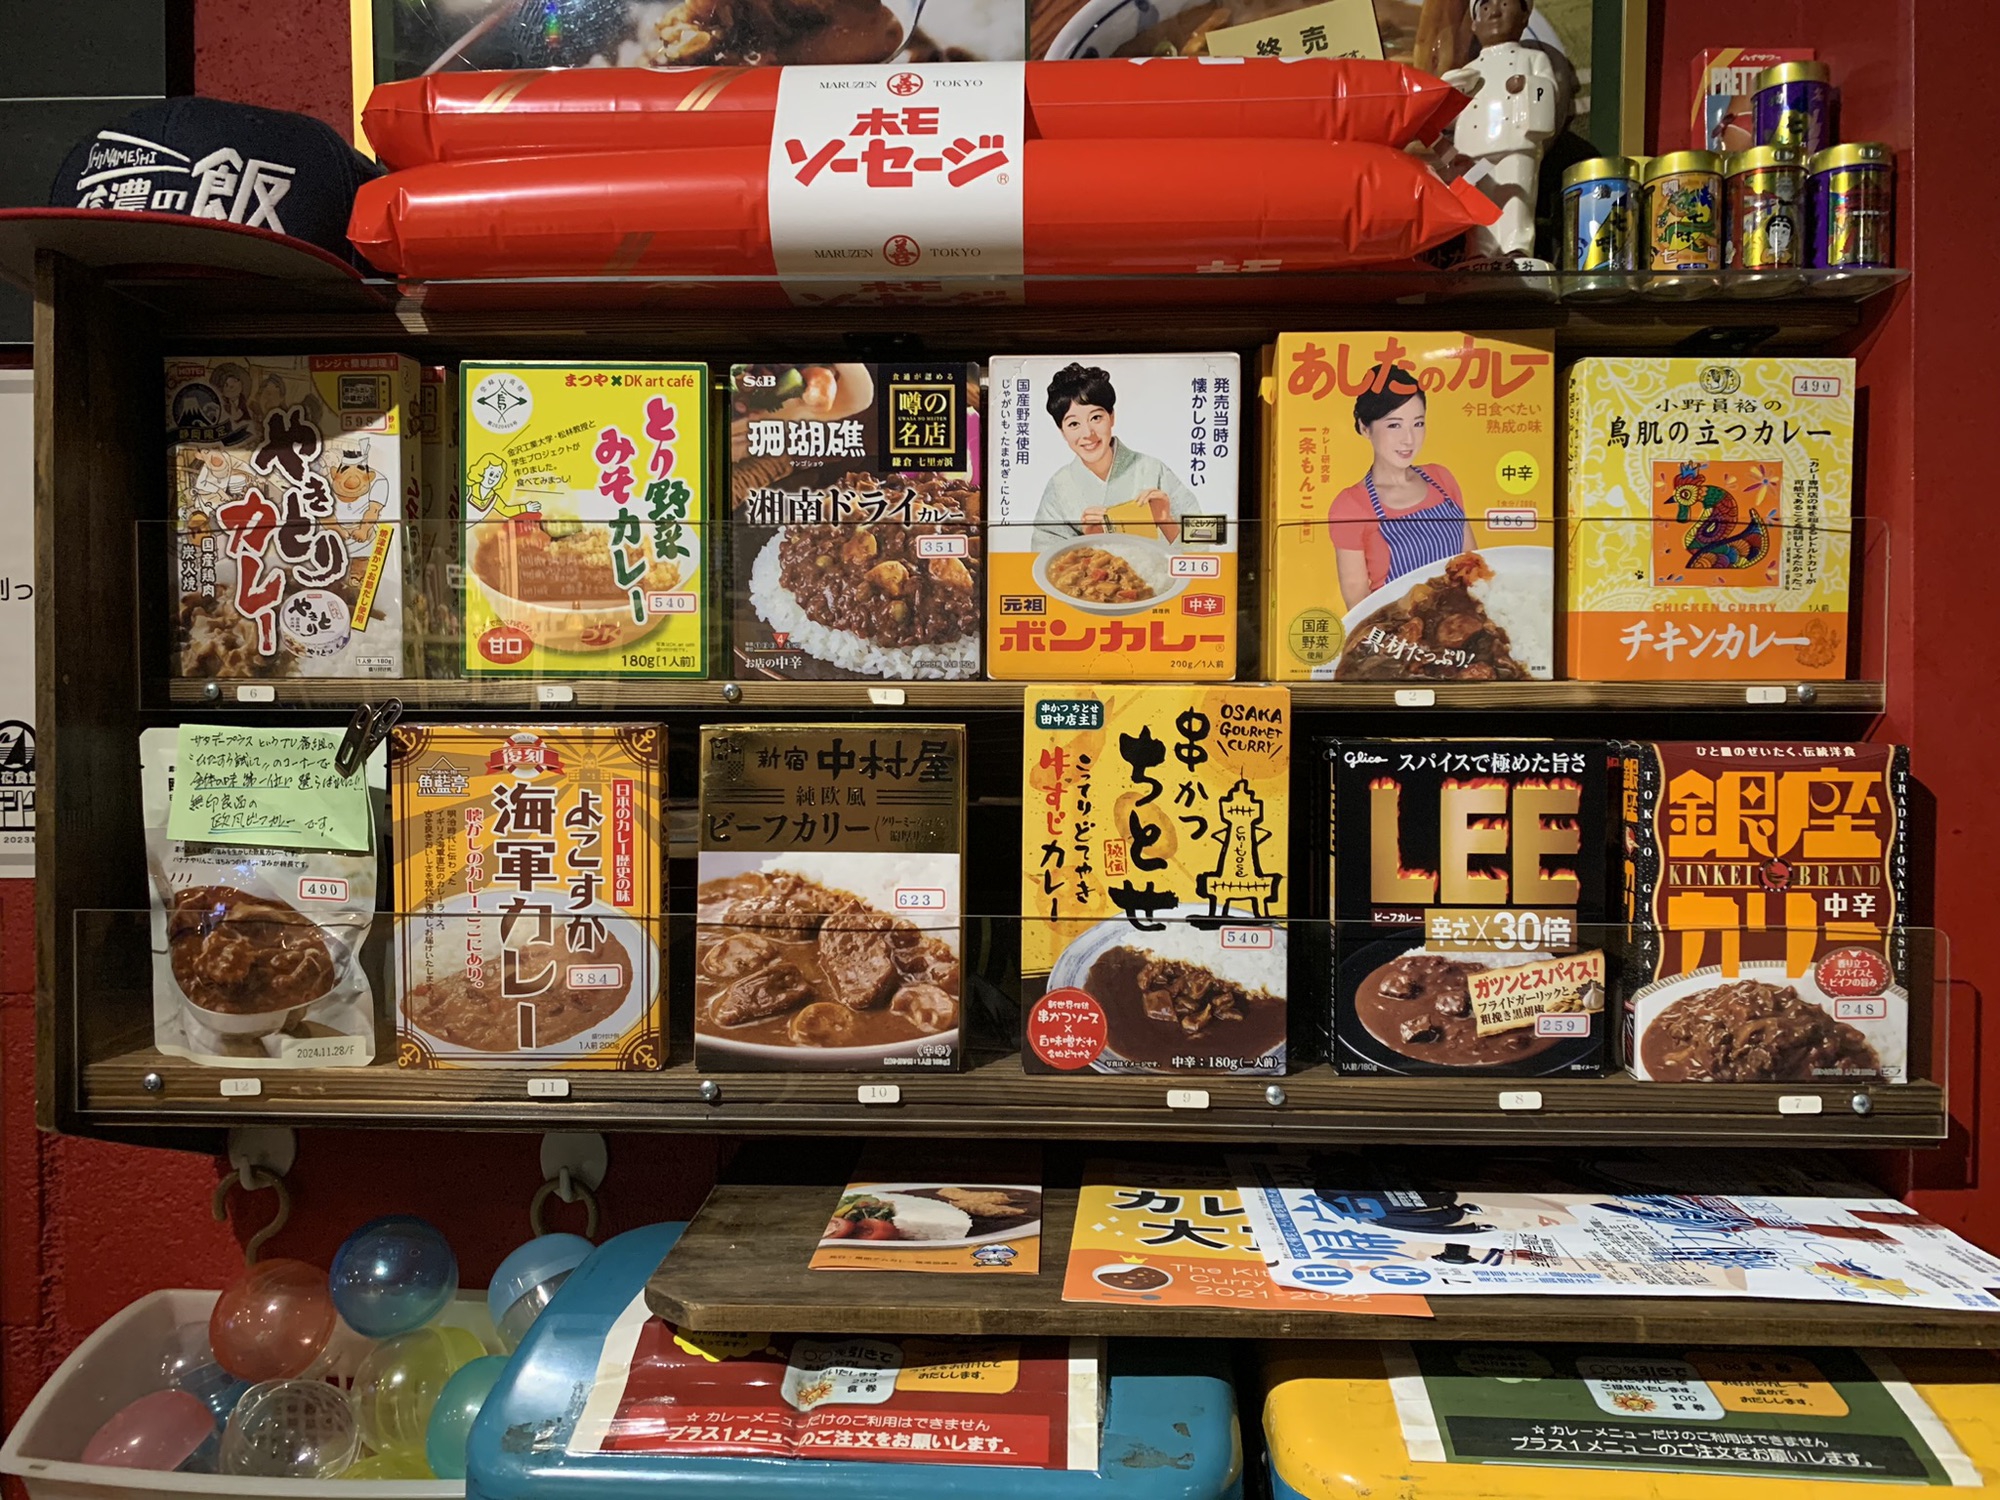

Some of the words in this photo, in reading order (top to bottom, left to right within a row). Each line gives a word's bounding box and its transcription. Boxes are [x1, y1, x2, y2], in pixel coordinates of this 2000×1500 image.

[819, 80, 878, 90] MARUZEN
[933, 79, 983, 88] TOKYO
[848, 107, 940, 136] ホモ
[784, 134, 1010, 188] ソーセージ
[814, 248, 874, 259] MARUZEN
[930, 247, 981, 258] TOKYO
[892, 372, 954, 381] 食通が認める
[1287, 336, 1549, 400] あしたのカレー
[645, 376, 664, 387] art
[666, 374, 694, 387] café
[743, 375, 777, 388] S&B
[1800, 380, 1831, 392] 490
[898, 391, 948, 416] 噂の
[1461, 401, 1542, 417] 今日食べたい
[1656, 398, 1782, 414] 小野員裕の
[344, 414, 374, 427] 598
[1015, 378, 1030, 466] 国産野菜使用
[1213, 377, 1230, 459] 発売当時の
[1486, 419, 1543, 434] 熟成の味
[748, 420, 866, 457] 珊瑚礁
[898, 422, 946, 447] 名店
[1190, 377, 1207, 487] 懐かしの味わい
[1606, 416, 1832, 448] 鳥肌の立つカレー
[510, 442, 581, 468] 学生プロジェクトが
[892, 456, 912, 467] 鎌倉
[1000, 378, 1011, 527] じゃがいも・たまねぎ・にんじん
[1320, 426, 1331, 484] カレー研究家
[513, 464, 558, 478] 作りました。
[1298, 426, 1317, 510] 一条もんこ
[1501, 464, 1534, 482] 中辛
[645, 397, 691, 559] とり野菜
[254, 406, 348, 584] やきとり
[595, 427, 646, 623] みそカレー
[1491, 515, 1524, 527] 486
[924, 541, 955, 553] 351
[181, 544, 197, 592] 炭火焼
[201, 535, 216, 598] 国産鶏肉
[217, 491, 284, 652] カレー
[1178, 561, 1209, 572] 216
[654, 598, 685, 608] 540
[1003, 598, 1043, 612] 元祖
[1189, 598, 1218, 611] 中辛
[1653, 603, 1720, 612] CHICKEN
[1728, 603, 1777, 612] CURRY
[1808, 603, 1830, 612] 1人前
[1302, 618, 1330, 633] 国産
[776, 634, 784, 645] 4
[1000, 619, 1225, 652] ボンカレー
[1301, 635, 1329, 649] 野菜
[1620, 619, 1811, 662] チキンカレー
[487, 636, 523, 655] 甘口
[1361, 626, 1475, 668] 具材たっぷり!
[621, 654, 696, 669] 180g[1人前]
[744, 656, 802, 669] お店の中辛
[1306, 651, 1323, 660] 使用
[546, 689, 554, 699] 5
[1040, 703, 1069, 713] 串かつ
[1071, 703, 1099, 713] ちとせ
[1220, 704, 1283, 724] OSAKA
[1040, 713, 1091, 725] 田中店主
[1219, 721, 1283, 739] GOURMET
[190, 732, 254, 747] サタデープラス
[1227, 739, 1275, 754] CURRY
[502, 747, 545, 764] 復刻
[756, 745, 809, 772] 新宿
[816, 737, 954, 783] 中村屋
[1696, 746, 1857, 758] ひと皿のぜいたく、伝統洋食
[1397, 752, 1587, 774] スパイスで極めた旨さ
[1174, 706, 1211, 841] 串かつ
[418, 775, 469, 795] 魚藍亭
[189, 795, 258, 811] 無印良品の
[796, 785, 867, 807] 純欧風
[1642, 771, 1653, 857] TOKYO
[1669, 767, 1882, 858] 銀座
[708, 811, 870, 845] ビーフカリー
[1040, 746, 1071, 923] 牛すじカレー
[1074, 754, 1096, 904] こってりどてやき
[1108, 725, 1180, 932] ちとせ
[1896, 771, 1907, 902] TRADITIONAL
[615, 782, 632, 903] 日本のカレー歴史の味
[1371, 782, 1581, 904] LEE
[565, 788, 608, 953] よこすか
[1669, 865, 1752, 885] KINKEI
[1799, 865, 1881, 885] BRAND
[308, 883, 338, 895] 490
[465, 808, 484, 989] 懐かしのカレーここにあり。
[899, 894, 931, 906] 623
[1824, 892, 1876, 919] 中辛
[492, 783, 559, 1050] 海軍カレー
[1373, 912, 1422, 923] ビーフカレー
[1642, 883, 1653, 970] GINZA
[1668, 892, 1882, 979] カリー
[1227, 931, 1260, 944] 540
[1896, 913, 1906, 971] TASTE
[1834, 968, 1874, 977] スパイスと
[1837, 959, 1871, 969] 香り立つ
[575, 972, 609, 985] 384
[1473, 958, 1600, 1000] ガツンとスパイス!
[1829, 977, 1878, 987] ビイフの旨み
[1477, 986, 1570, 1013] フライドガーリックと
[1037, 1008, 1100, 1024] 串かつソース
[1480, 1005, 1546, 1026] 粗挽き黒胡椒
[1841, 1003, 1875, 1015] 248
[1542, 1020, 1576, 1032] 259
[870, 1086, 888, 1098] 10
[1182, 1093, 1191, 1103] 9
[1170, 1263, 1222, 1276] The
[1189, 1273, 1266, 1290] Curry
[1600, 1383, 1697, 1395] ご提供いたします。
[1669, 1394, 1698, 1403] 100
[1551, 1424, 1829, 1449] カレーメニューだけのご利用はできません
[1511, 1435, 1874, 1467] プラス1メニューのご注文をお願いします。
